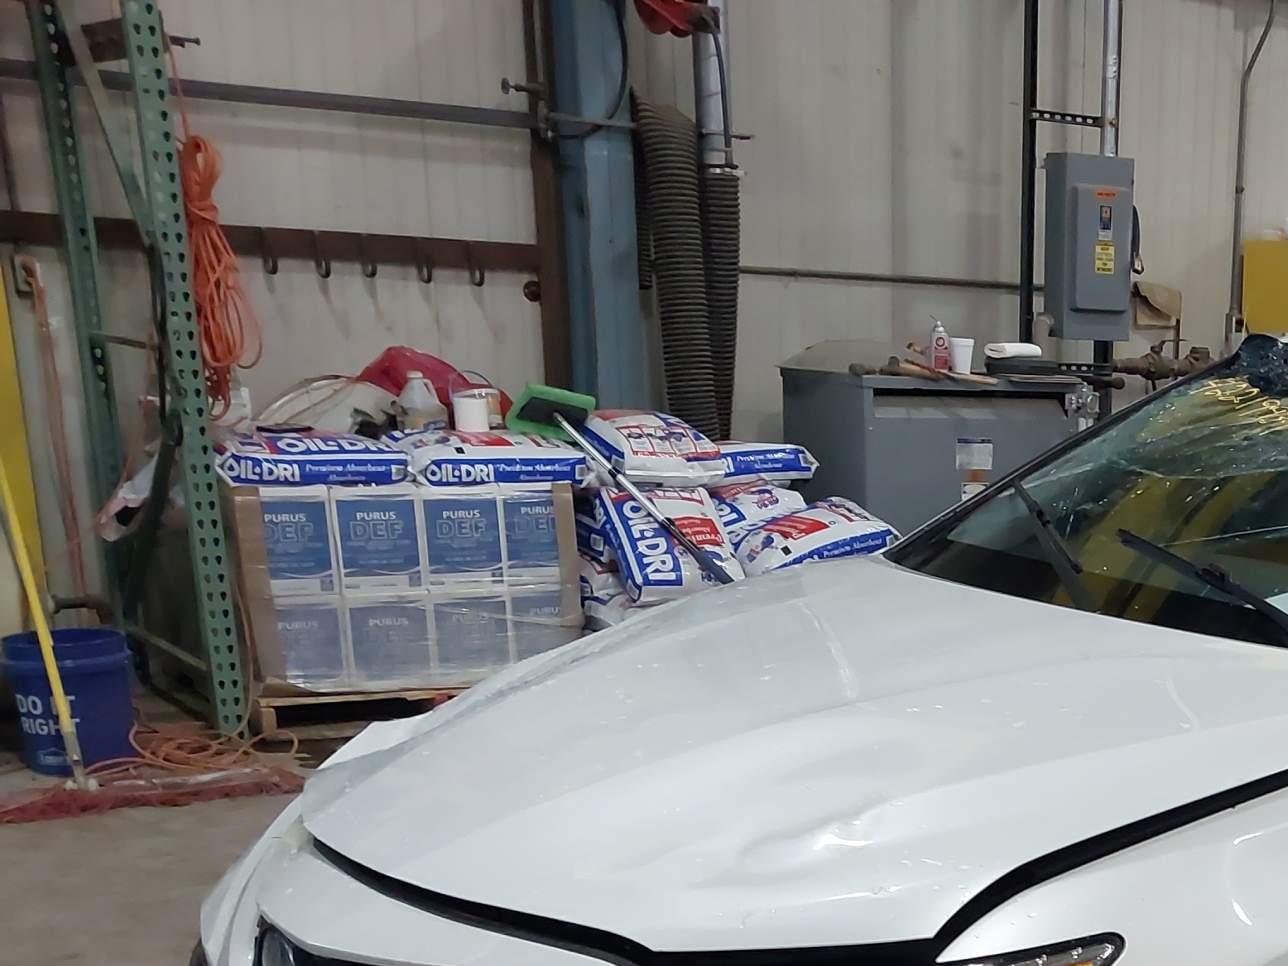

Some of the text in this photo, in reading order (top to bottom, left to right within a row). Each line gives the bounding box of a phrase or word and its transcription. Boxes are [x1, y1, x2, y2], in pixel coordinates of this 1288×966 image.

[264, 512, 307, 523] PURUS
[356, 510, 397, 521] PURUS
[442, 509, 481, 519] PURUS
[350, 520, 404, 541] DEF
[436, 518, 488, 538] DEF
[15, 694, 43, 716] DO
